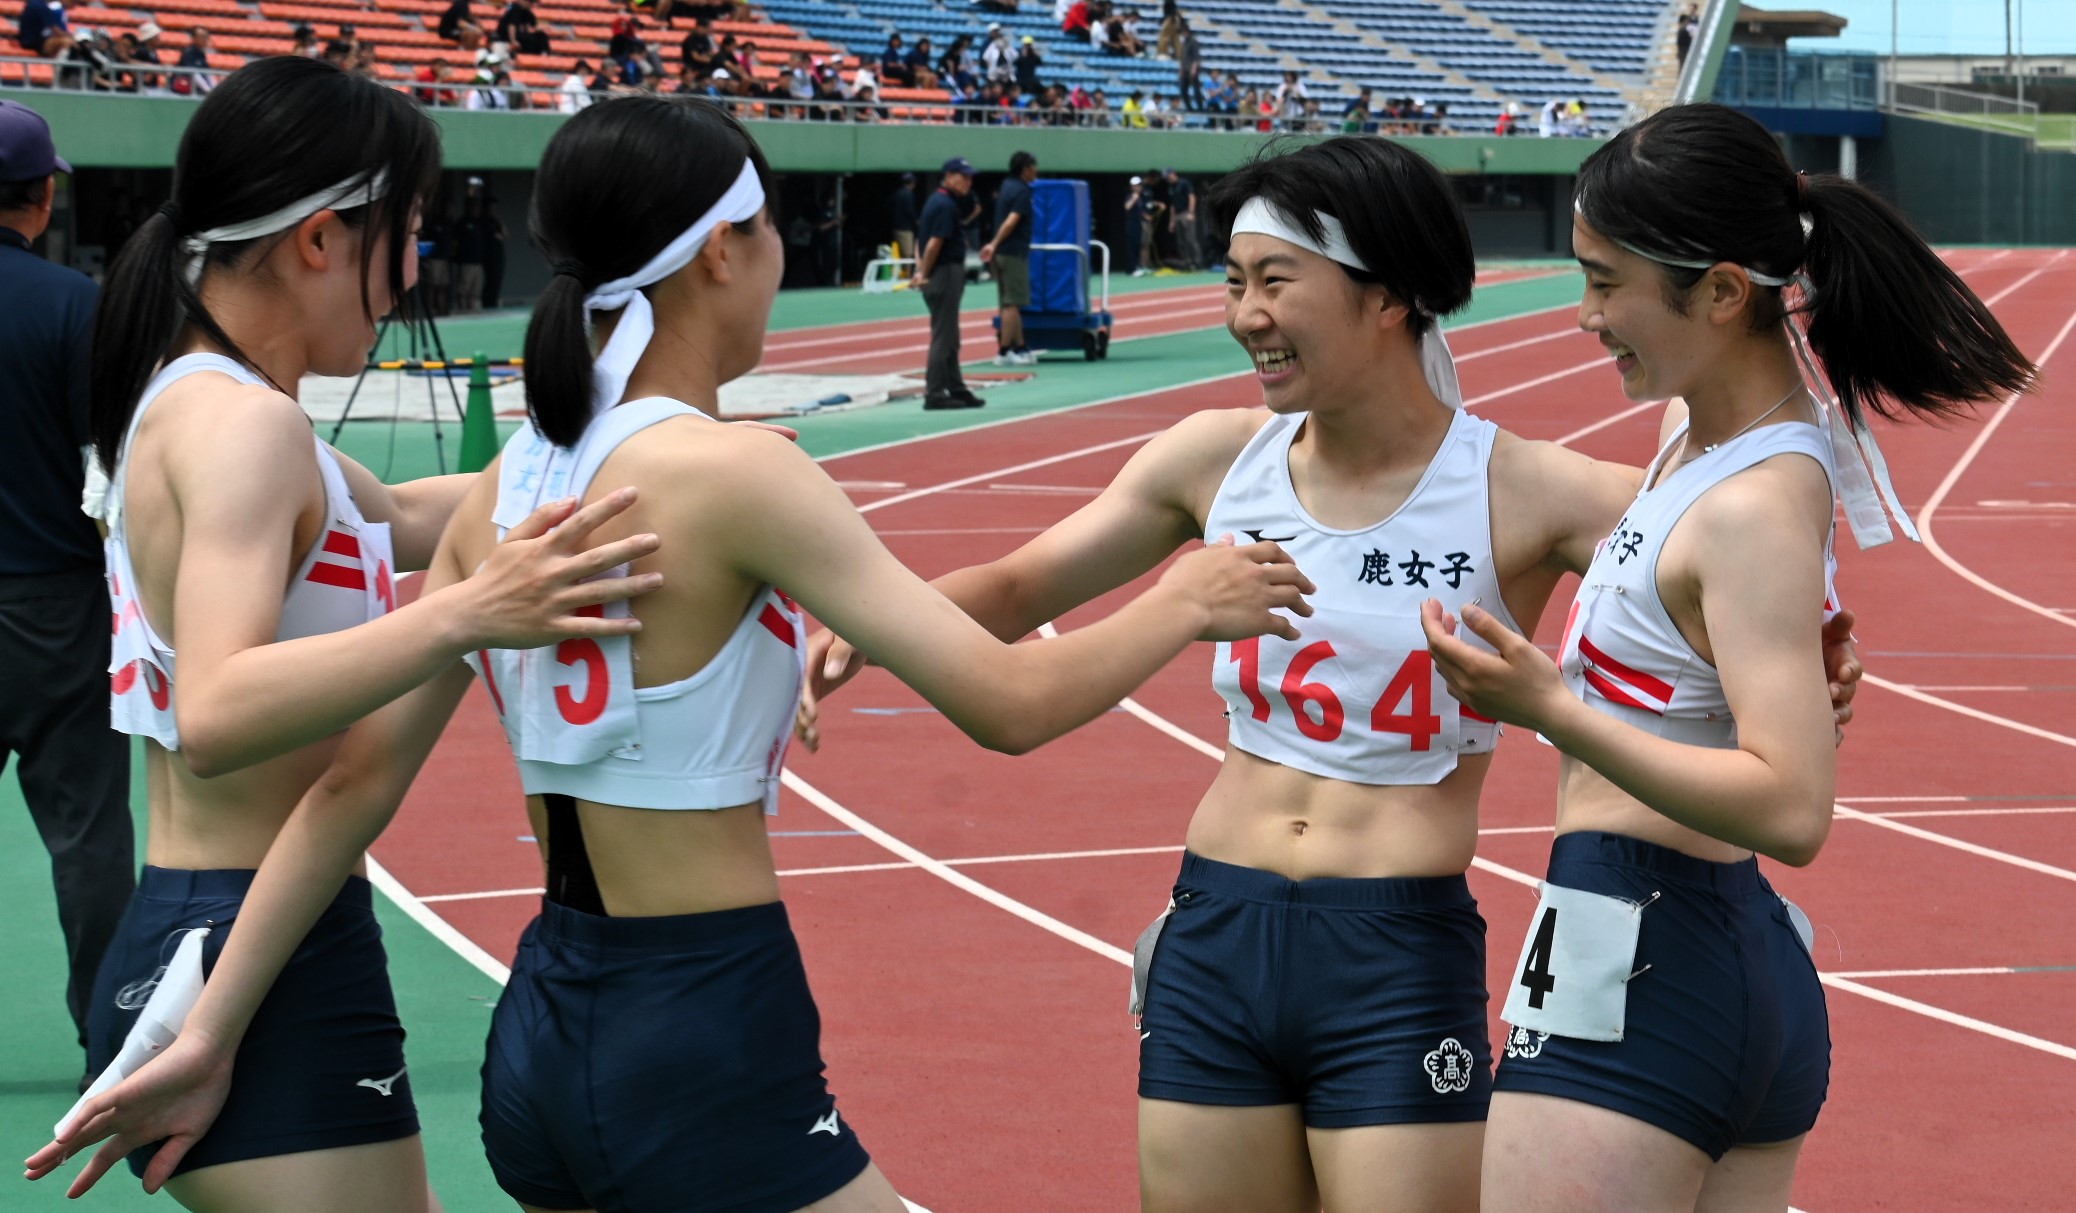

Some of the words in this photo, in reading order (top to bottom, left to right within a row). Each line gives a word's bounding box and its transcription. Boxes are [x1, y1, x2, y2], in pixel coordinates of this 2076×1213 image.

[1356, 547, 1475, 590] 鹿女子
[1229, 634, 1441, 752] 164
[1521, 906, 1557, 1009] 4
